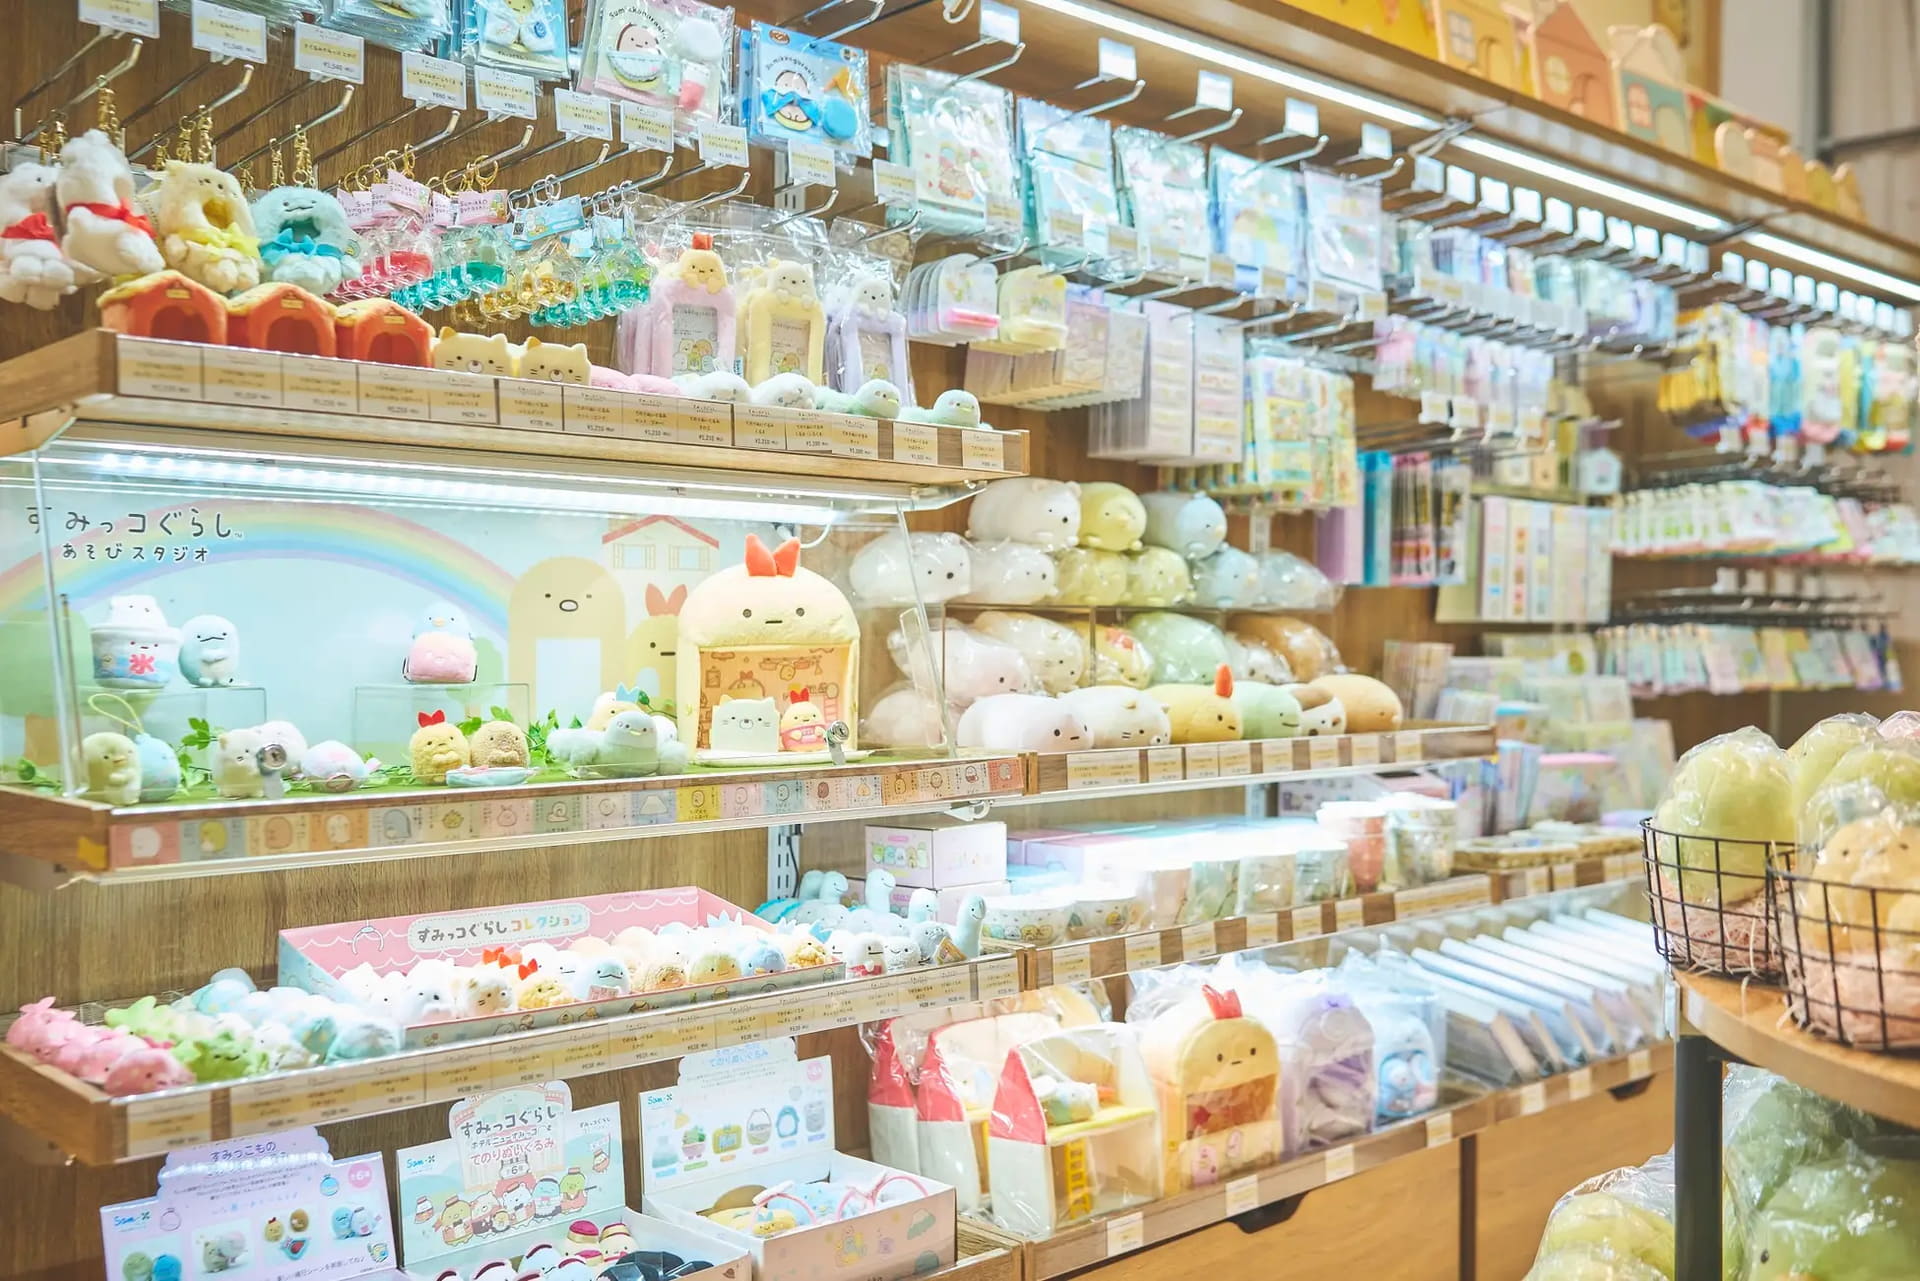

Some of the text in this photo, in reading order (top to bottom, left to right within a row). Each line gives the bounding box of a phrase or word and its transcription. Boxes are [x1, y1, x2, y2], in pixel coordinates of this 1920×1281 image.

[27, 507, 231, 538] すみっコぐらし
[63, 543, 208, 561] あそびスタジオ
[461, 1105, 556, 1138] すみっコぐらし
[470, 1138, 556, 1166] てのりぬいぐるみ
